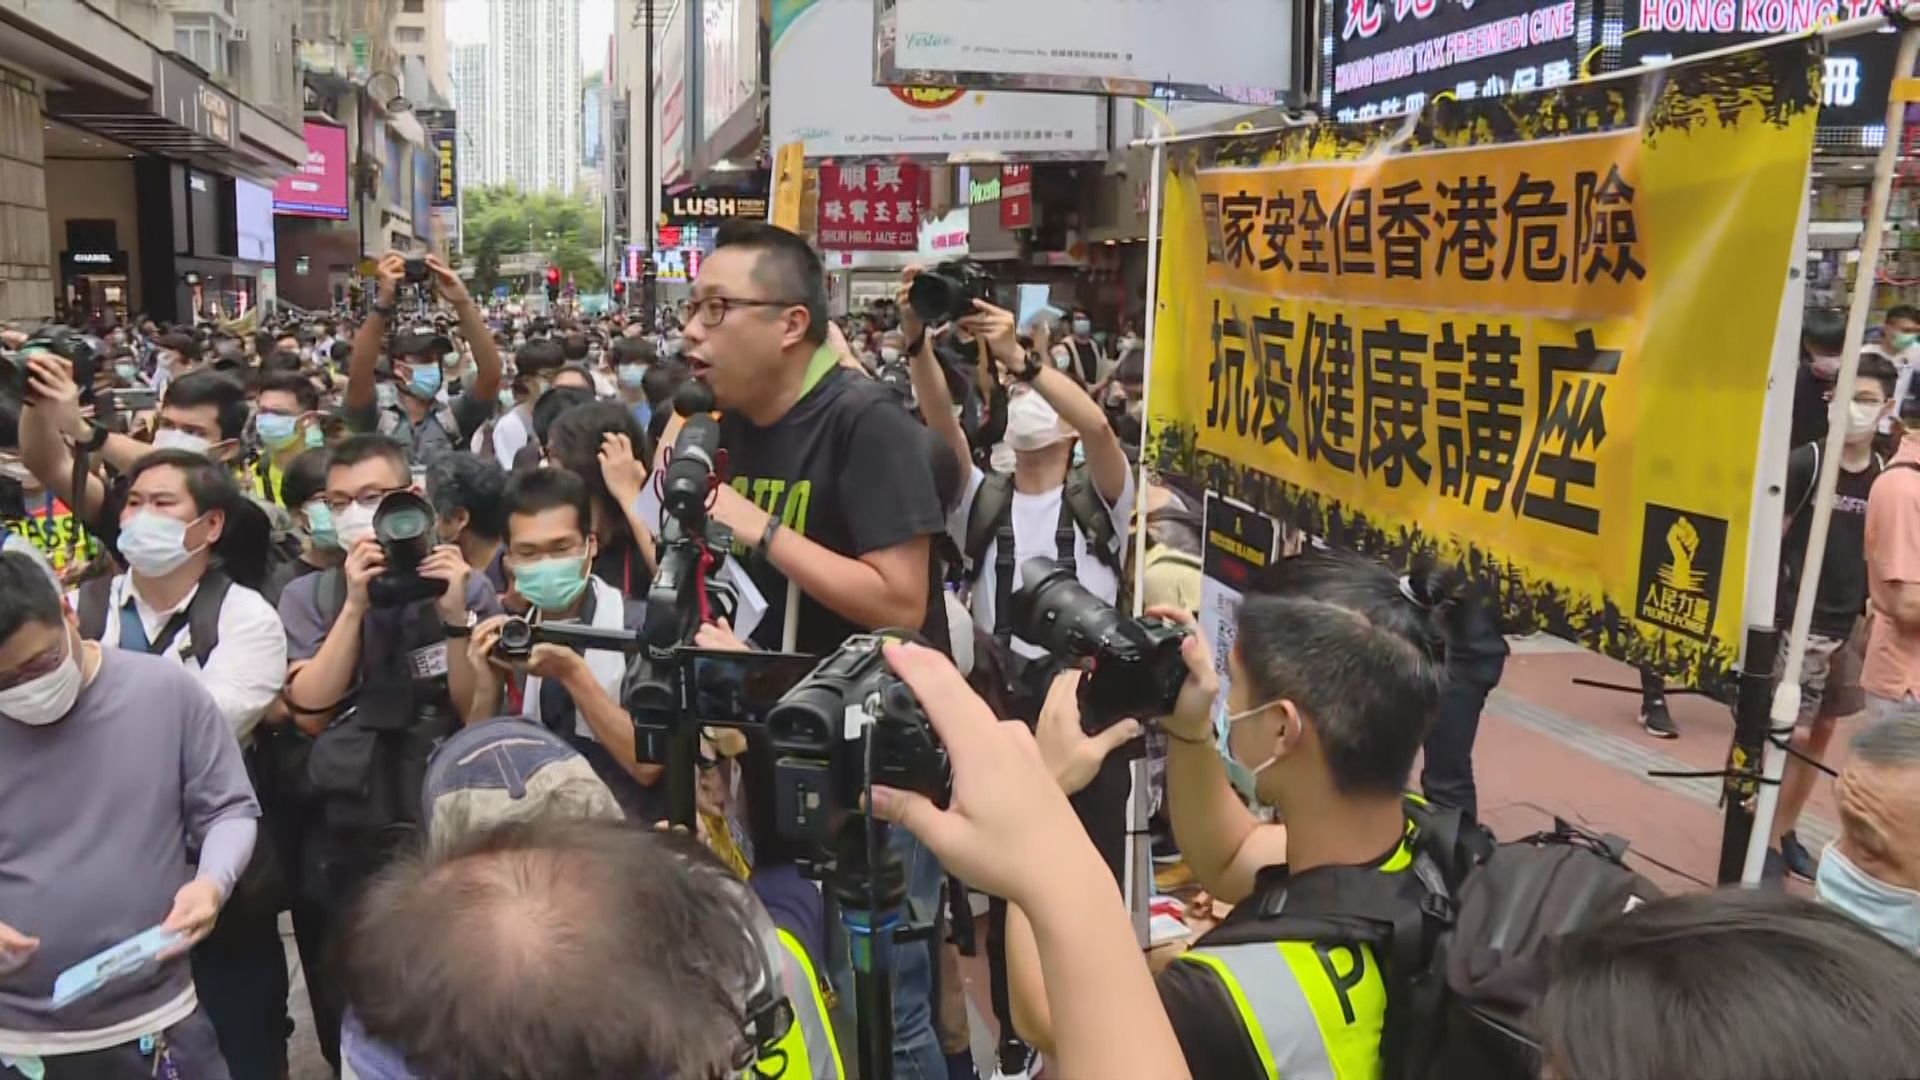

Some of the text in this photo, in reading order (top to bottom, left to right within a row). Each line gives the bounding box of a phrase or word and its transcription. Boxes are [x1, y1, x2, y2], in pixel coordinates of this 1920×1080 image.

[1640, 0, 1734, 33] HONG
[1415, 38, 1447, 73] TAX
[673, 197, 735, 216] LUSH
[821, 229, 848, 244] SHUN
[874, 230, 898, 246] JADE
[73, 253, 111, 263] CHANEL
[1206, 299, 1624, 536] 抗疫健康講座
[1643, 582, 1711, 623] 人民力量
